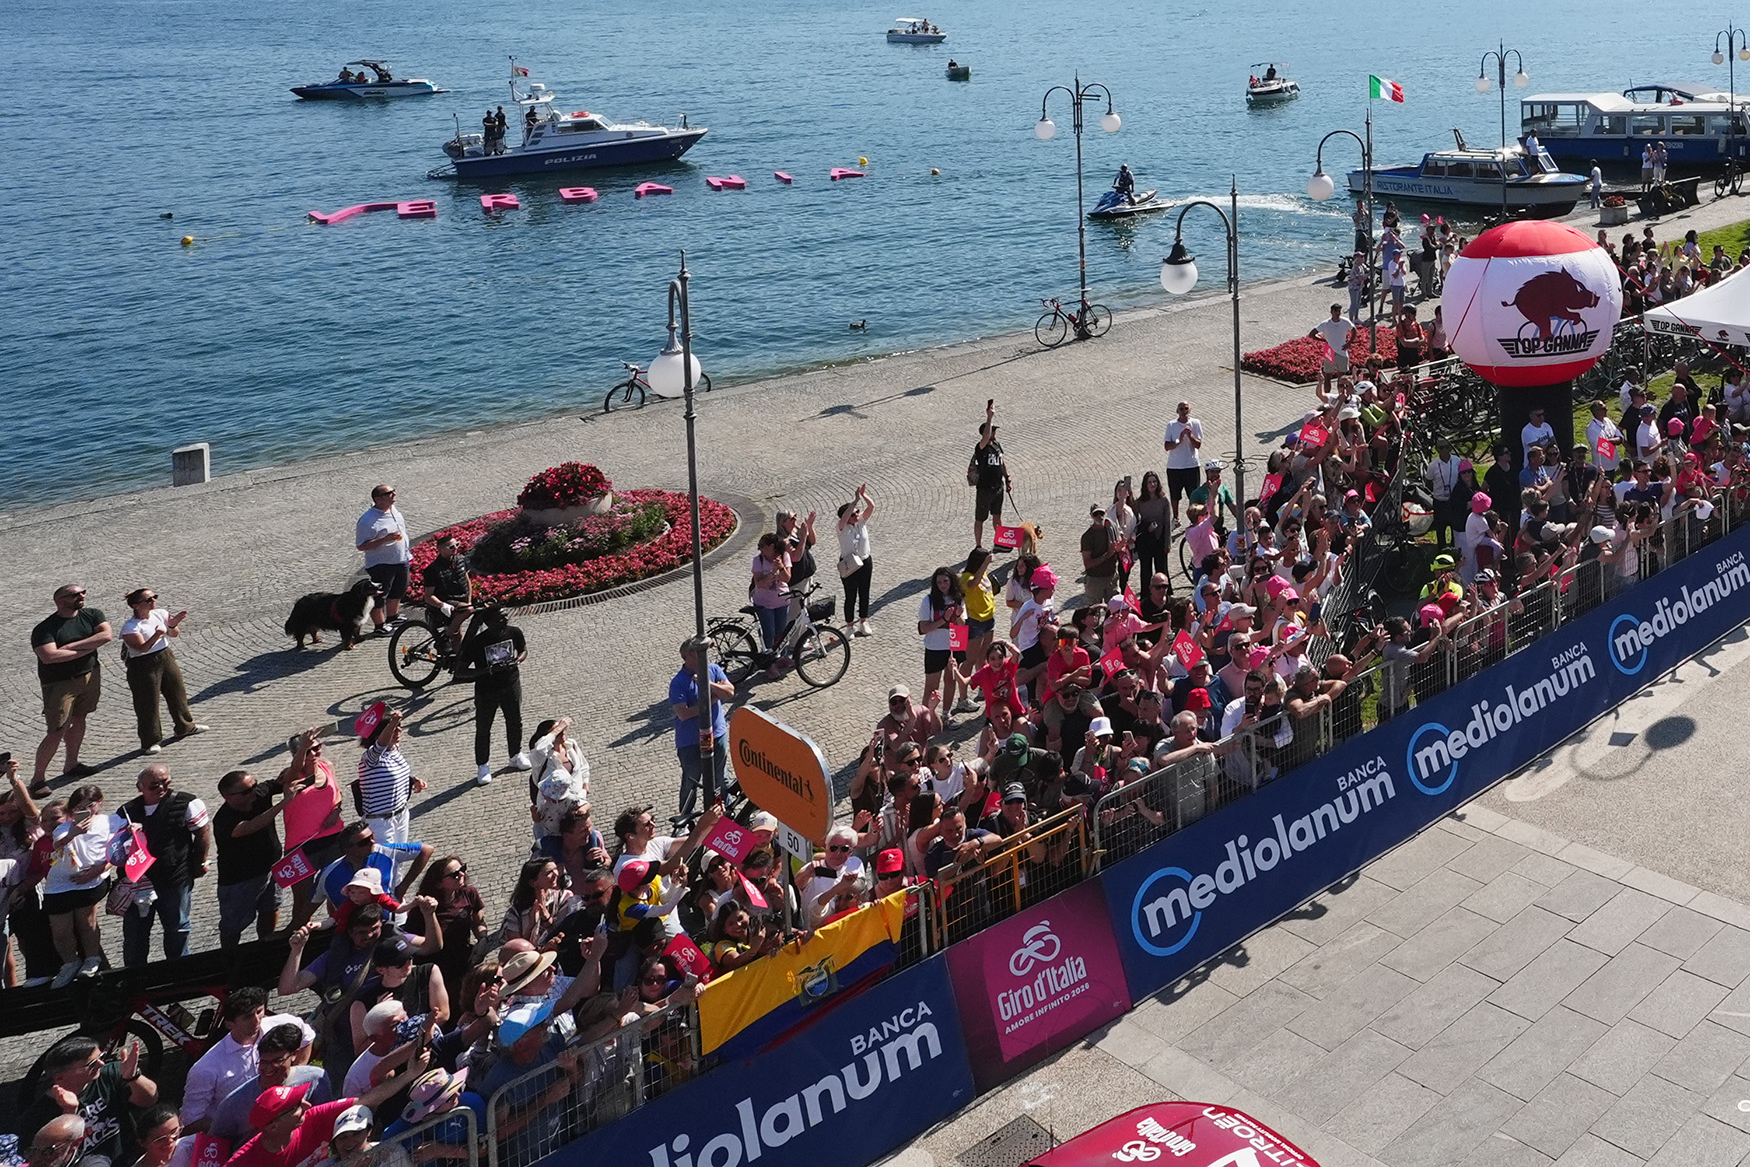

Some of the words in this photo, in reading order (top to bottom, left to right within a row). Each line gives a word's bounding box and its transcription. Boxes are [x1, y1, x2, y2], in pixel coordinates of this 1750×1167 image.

[544, 153, 597, 165] POLIZIA
[1376, 180, 1424, 193] RISTORANTE
[1425, 186, 1453, 195] ITALIA
[1516, 336, 1541, 355] TOP
[1543, 330, 1588, 354] GANNA
[1656, 320, 1670, 332] TOP
[1716, 551, 1745, 574] BANCA
[1551, 641, 1588, 670] BANCA
[1414, 655, 1596, 780] mediolanum
[739, 738, 804, 798] Continental
[1336, 755, 1388, 792] BANCA
[787, 831, 799, 852] 50
[1142, 771, 1396, 938] mediolanum
[998, 984, 1034, 1021] Giro
[1034, 956, 1087, 1002] d'Italia
[141, 1003, 192, 1046] TREK
[1005, 1012, 1034, 1034] AMORE
[1036, 994, 1070, 1017] INFINITO
[1071, 982, 1090, 1000] 2026
[850, 1000, 932, 1056] BANCA
[1166, 1135, 1196, 1156] Giro
